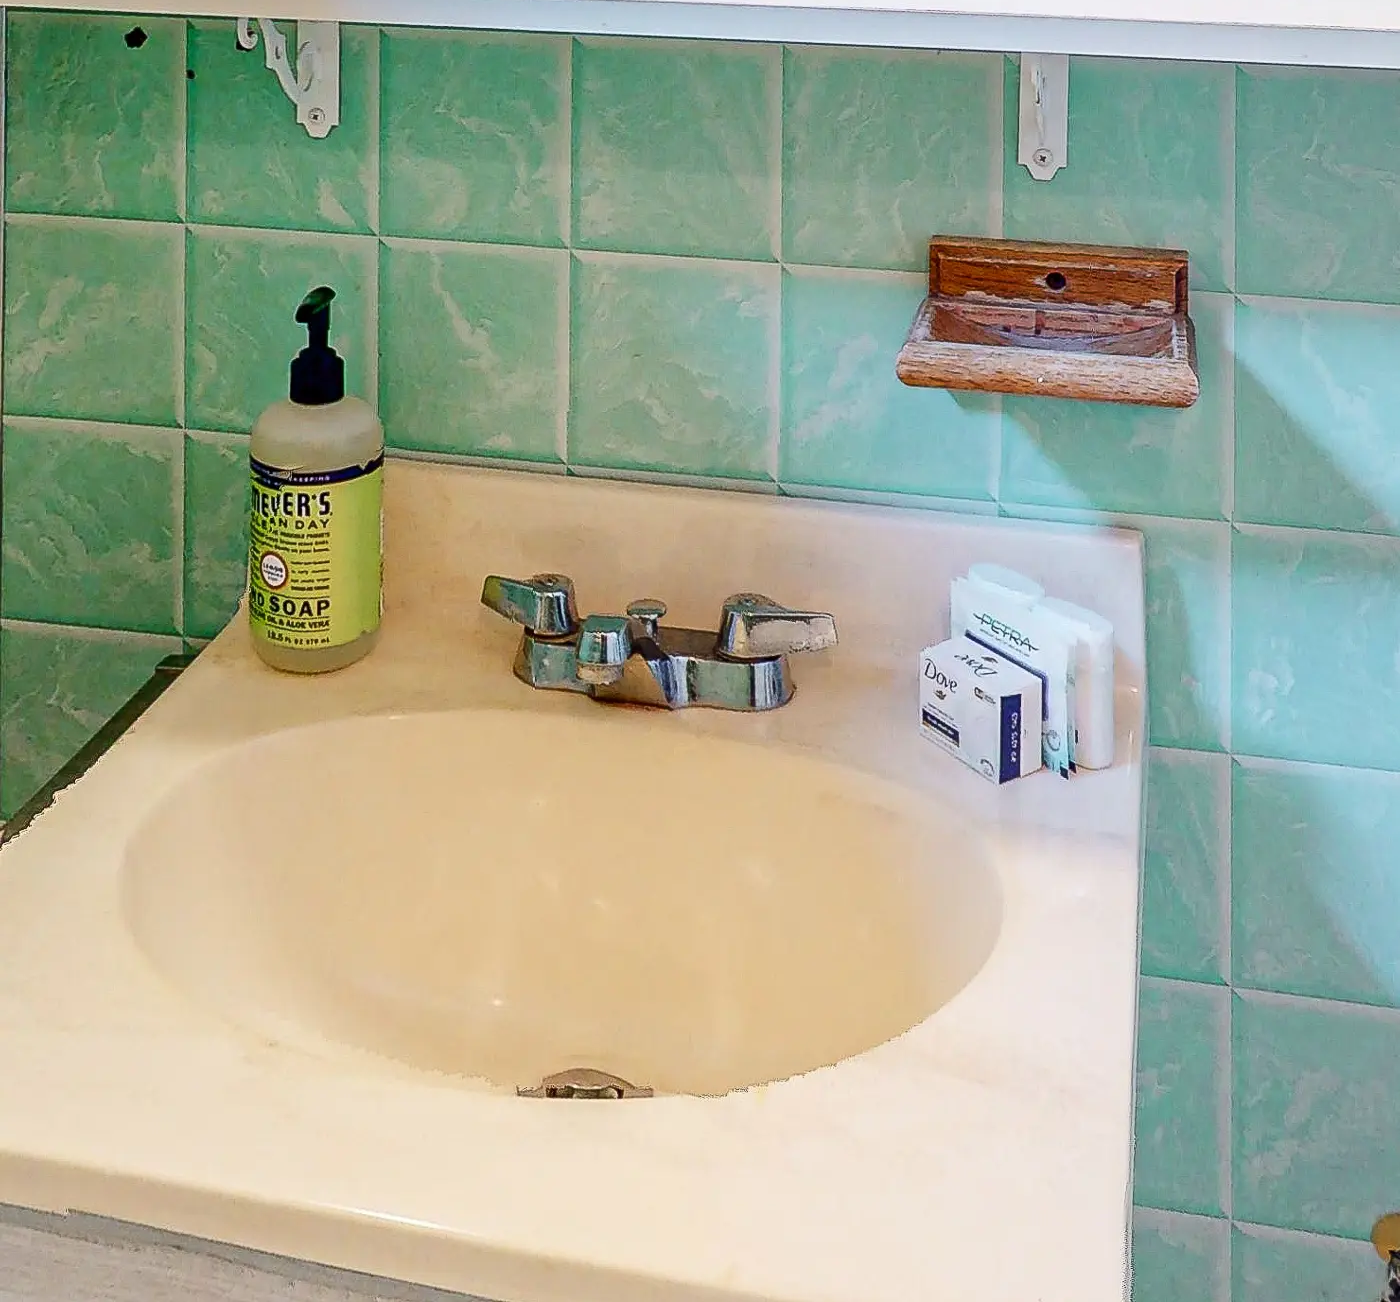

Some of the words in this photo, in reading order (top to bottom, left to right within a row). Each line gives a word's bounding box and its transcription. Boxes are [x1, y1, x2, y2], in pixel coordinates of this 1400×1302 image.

[294, 518, 330, 530] DAY
[269, 595, 331, 617] SOAP
[285, 619, 307, 629] ALOE
[308, 619, 330, 629] VERA
[973, 613, 1039, 652] PETRA
[924, 658, 958, 694] Dove
